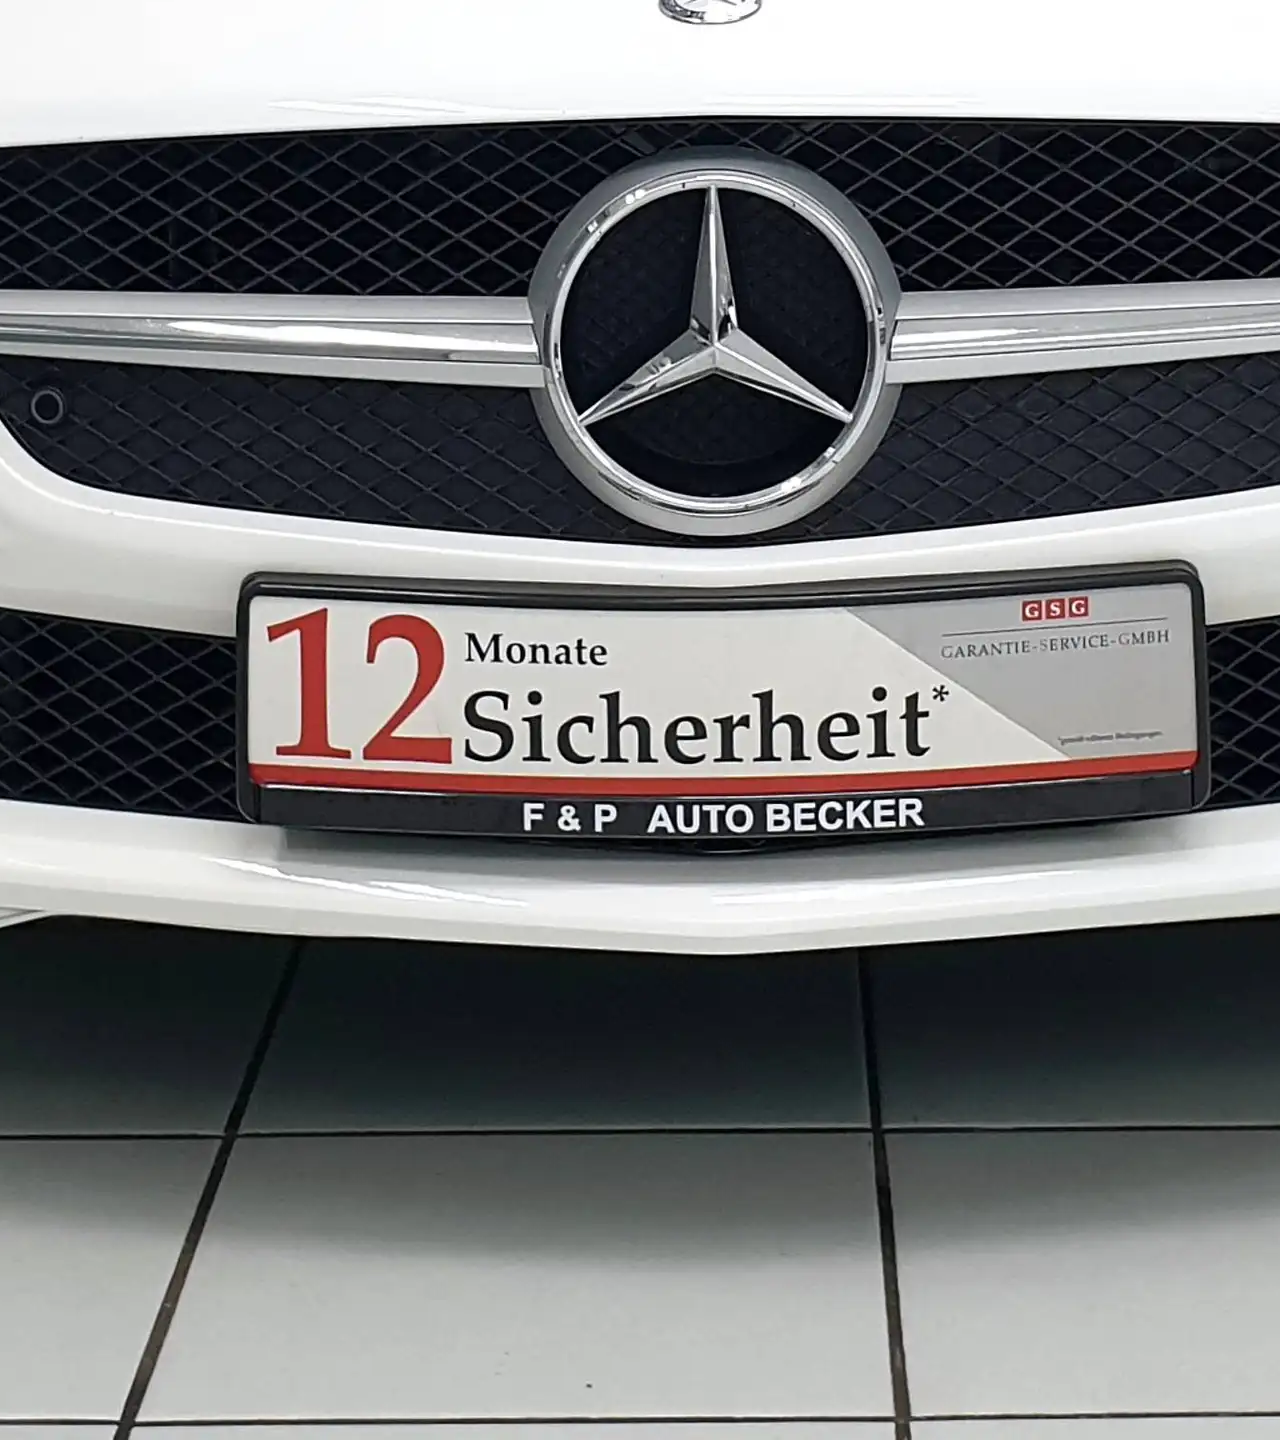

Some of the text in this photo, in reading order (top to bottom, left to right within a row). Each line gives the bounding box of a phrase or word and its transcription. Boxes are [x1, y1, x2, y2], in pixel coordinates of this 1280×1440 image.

[1022, 596, 1090, 622] GSG
[266, 607, 608, 762] 12 Monate
[523, 799, 925, 834] F & P AUTO BECKER
